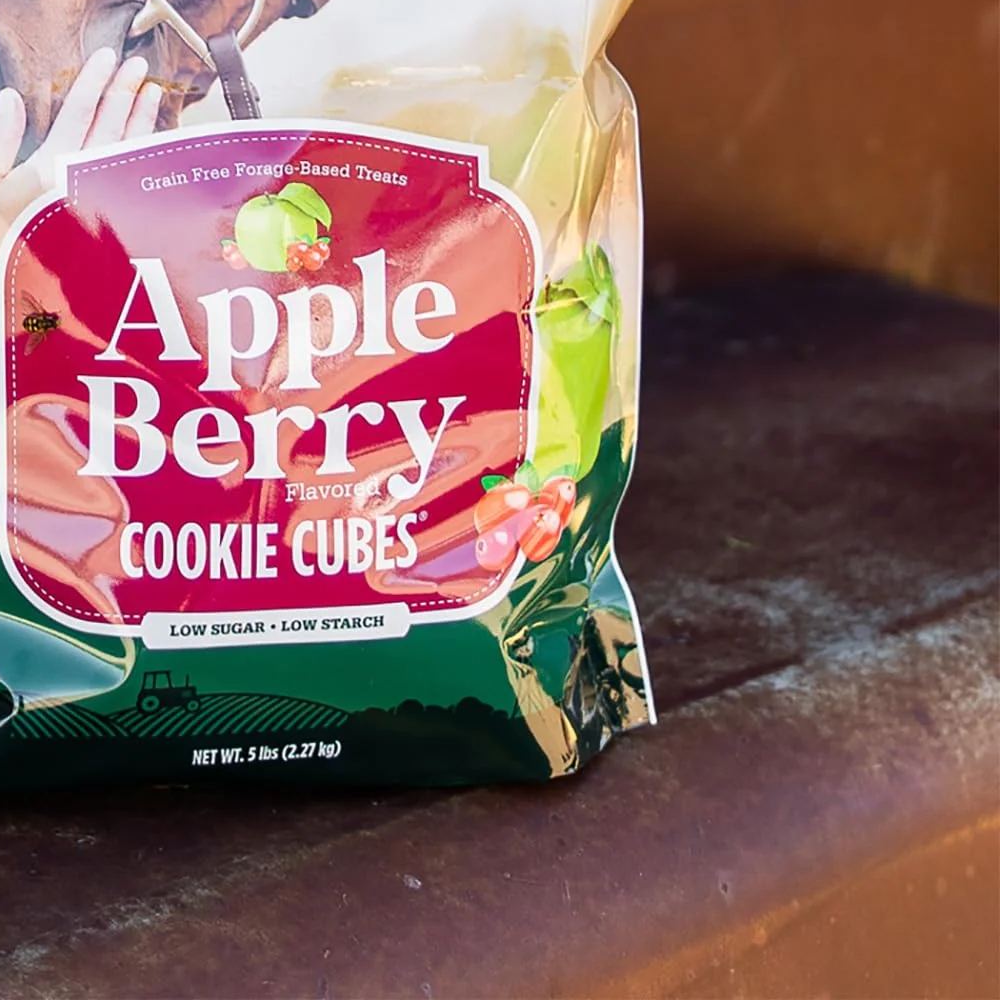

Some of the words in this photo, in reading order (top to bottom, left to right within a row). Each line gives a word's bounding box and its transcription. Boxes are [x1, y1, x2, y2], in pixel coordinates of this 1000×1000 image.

[140, 171, 188, 192] Grain
[191, 165, 230, 183] Free
[234, 160, 351, 183] Forage-Based
[356, 163, 408, 187] Treats
[94, 248, 456, 392] Apple
[76, 375, 468, 499] Berry
[285, 480, 382, 503] Flavored
[119, 521, 279, 580] COOKIE
[169, 623, 207, 638] LOW
[210, 621, 265, 636] SUGAR
[281, 618, 318, 633] LOW
[321, 615, 385, 631] STARCH
[192, 749, 218, 766] NET
[220, 747, 245, 765] WT.
[248, 746, 257, 762] 5
[259, 744, 279, 761] lbs
[281, 741, 315, 761] (2.27
[316, 739, 342, 760] kg)
